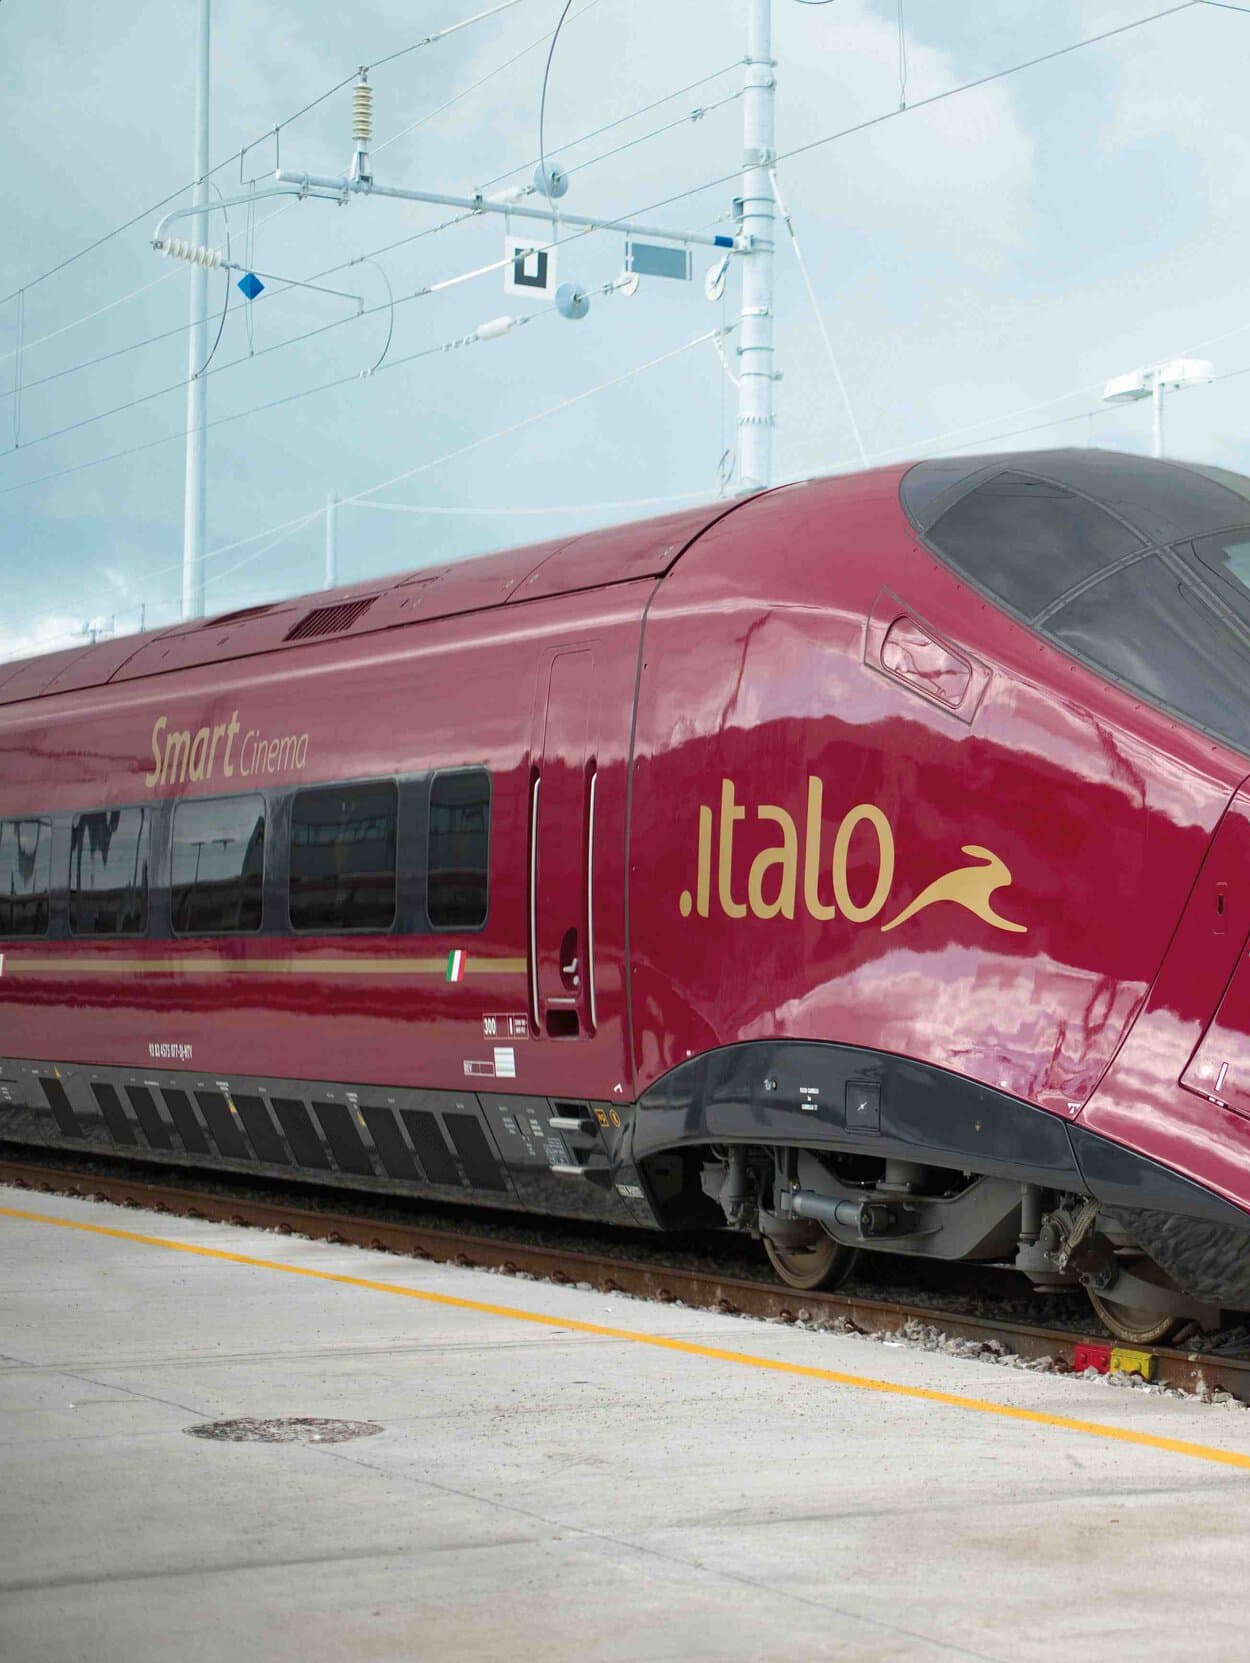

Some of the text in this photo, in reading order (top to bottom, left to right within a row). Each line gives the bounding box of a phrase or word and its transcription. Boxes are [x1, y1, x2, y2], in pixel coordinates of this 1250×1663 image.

[145, 710, 309, 788] Smart Cinema
[483, 1017, 496, 1035] 300
